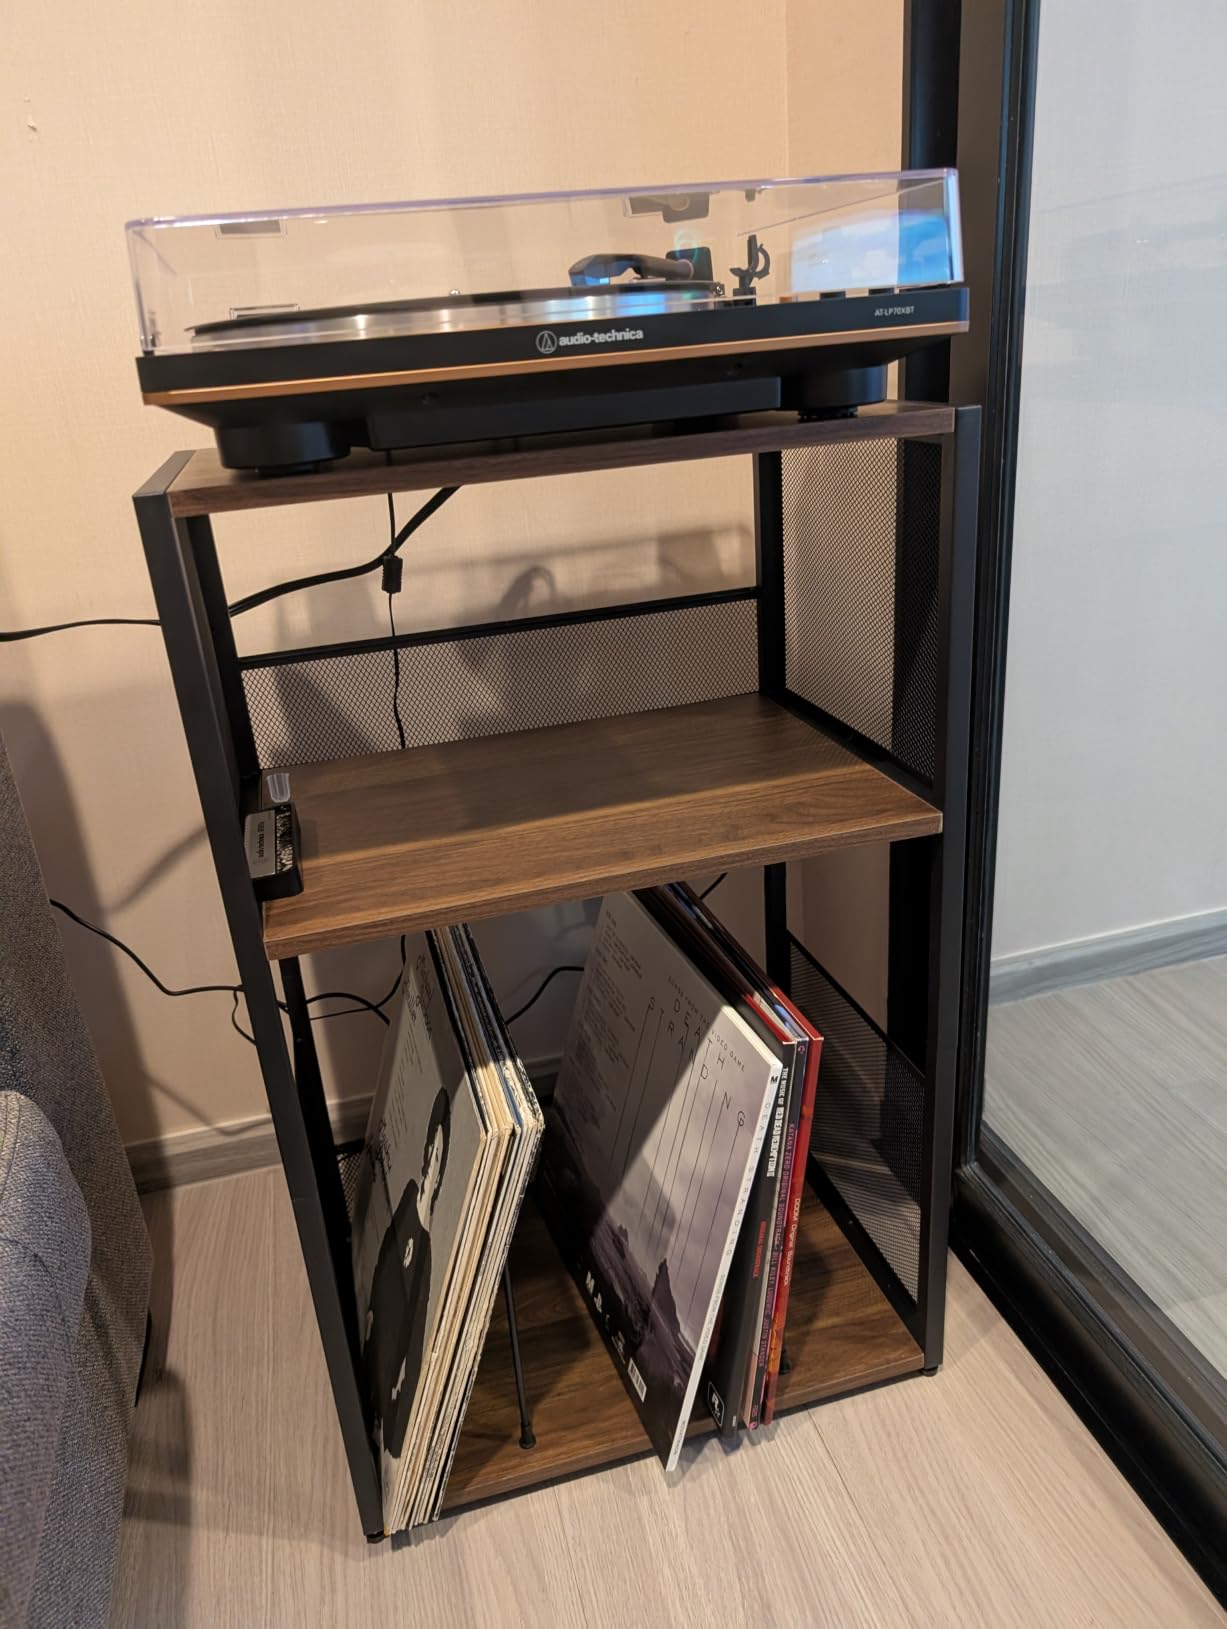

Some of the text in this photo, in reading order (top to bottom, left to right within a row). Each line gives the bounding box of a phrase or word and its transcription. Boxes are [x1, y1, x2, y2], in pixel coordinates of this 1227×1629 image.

[559, 328, 644, 346] audio-technica
[711, 1029, 728, 1051] VIDEO
[729, 1050, 745, 1073] GAME
[779, 1080, 787, 1097] MUSIC
[786, 1123, 795, 1150] KATANA
[784, 1152, 792, 1170] ZERO
[780, 1171, 789, 1201] ORIGINAL
